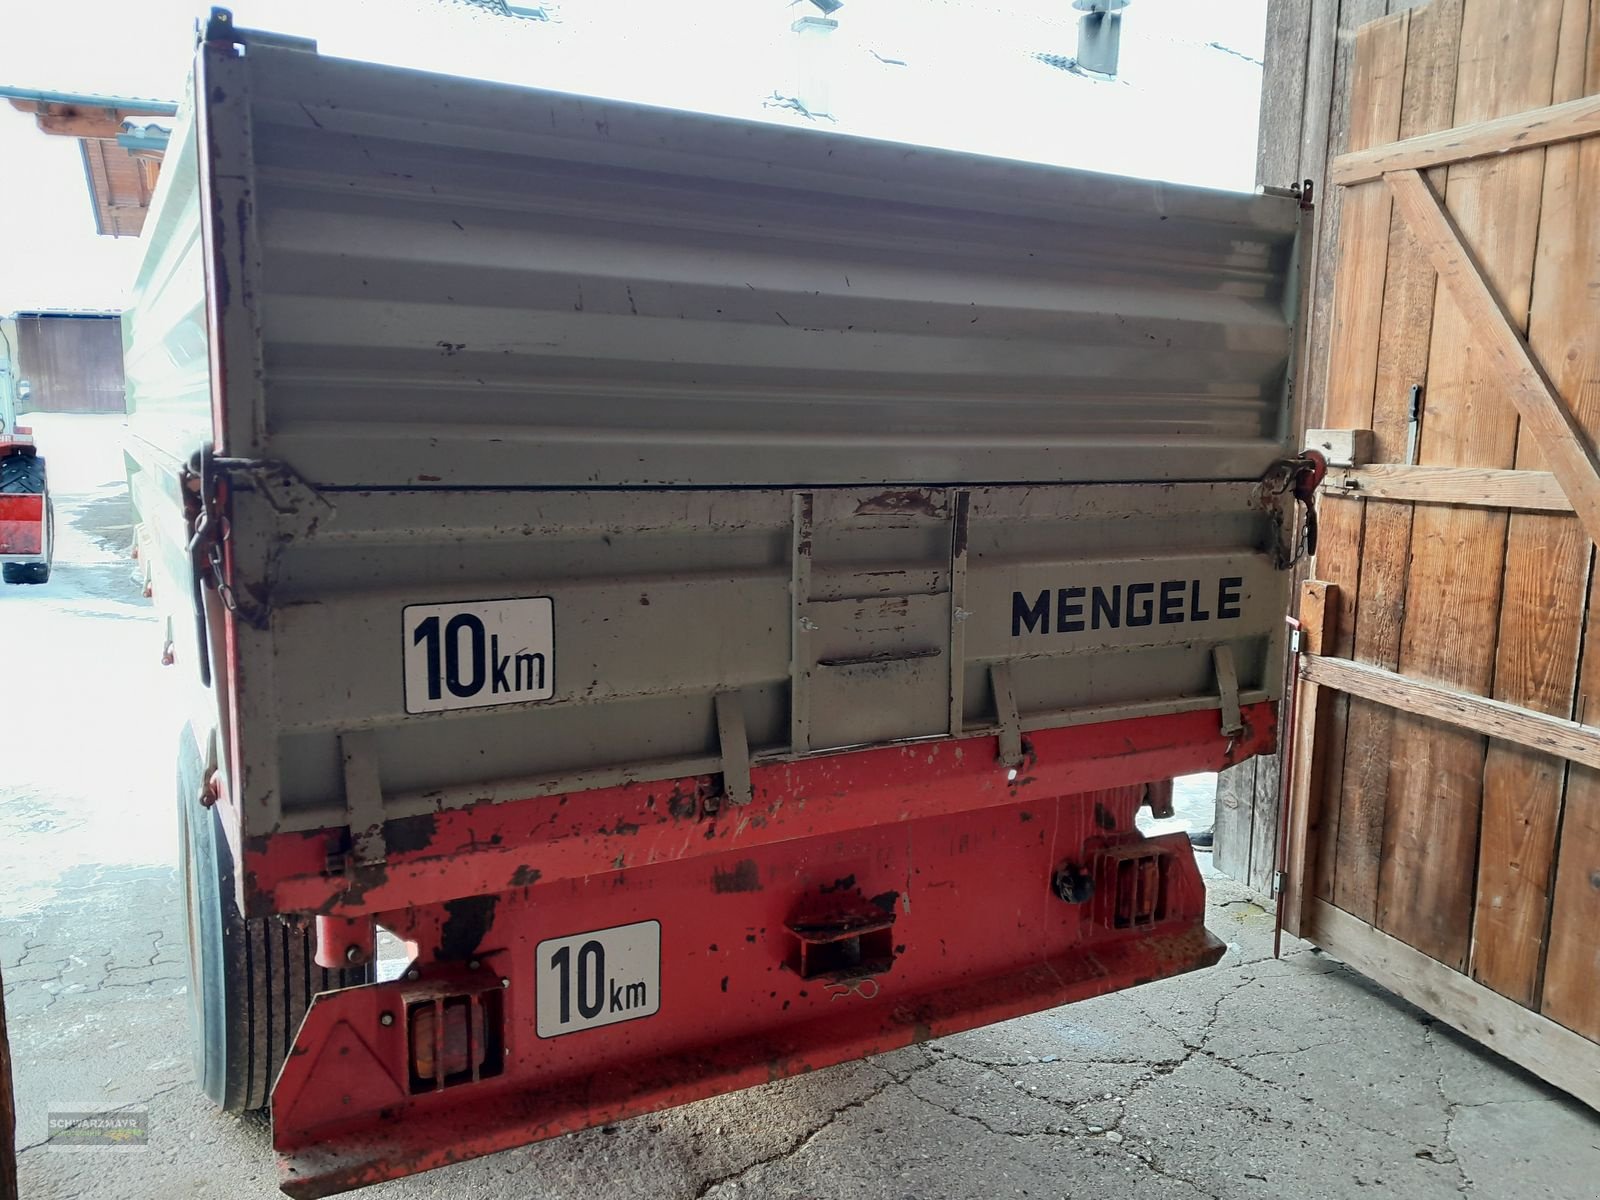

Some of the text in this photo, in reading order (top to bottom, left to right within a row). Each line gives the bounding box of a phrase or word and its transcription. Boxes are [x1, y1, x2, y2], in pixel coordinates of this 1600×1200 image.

[1012, 577, 1243, 636] MENGELE
[414, 613, 545, 700] 10 km
[551, 940, 646, 1024] 10 km
